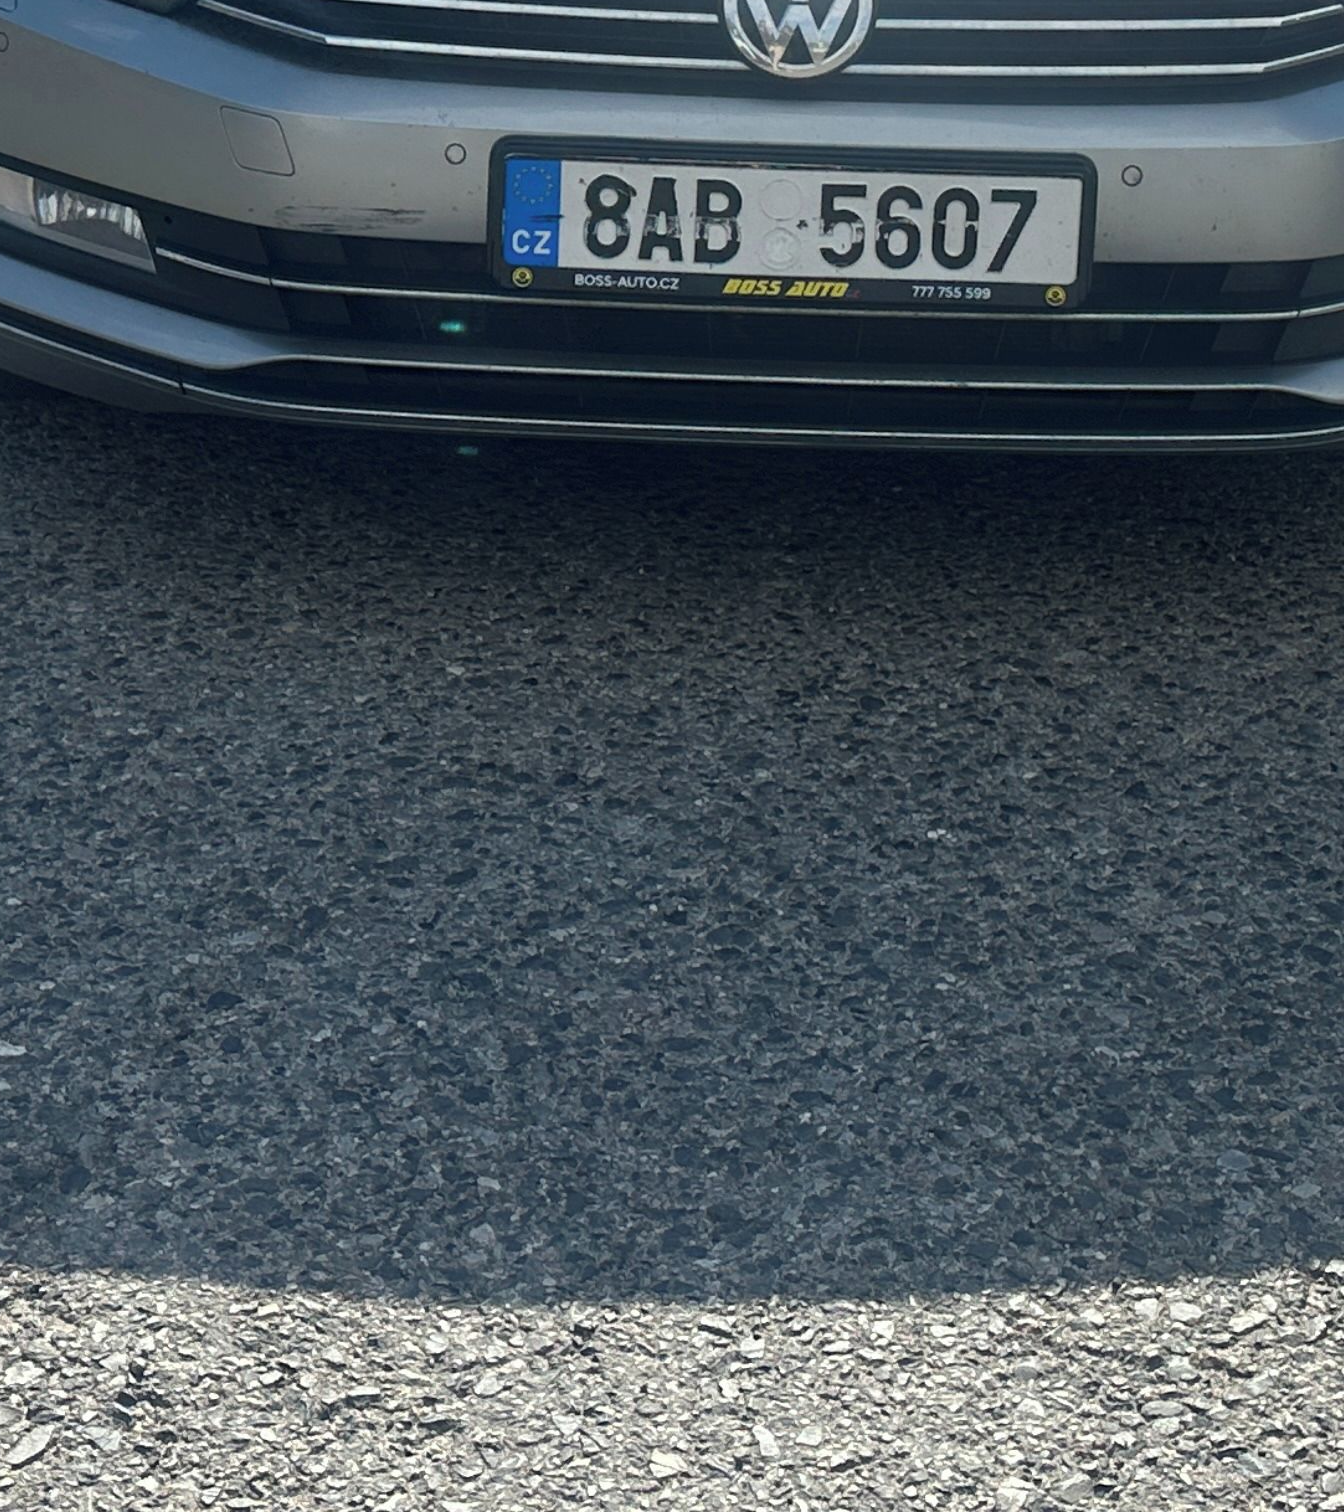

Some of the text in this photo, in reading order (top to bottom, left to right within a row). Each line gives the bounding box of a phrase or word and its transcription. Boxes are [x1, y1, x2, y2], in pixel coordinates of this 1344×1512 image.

[583, 173, 1038, 273] 8AB 5607
[511, 228, 552, 256] CZ
[574, 273, 680, 290] BOSS-AUTO.CZ
[722, 278, 783, 296] BOSS
[785, 280, 850, 298] AUTO
[912, 285, 992, 301] 777 755 599
